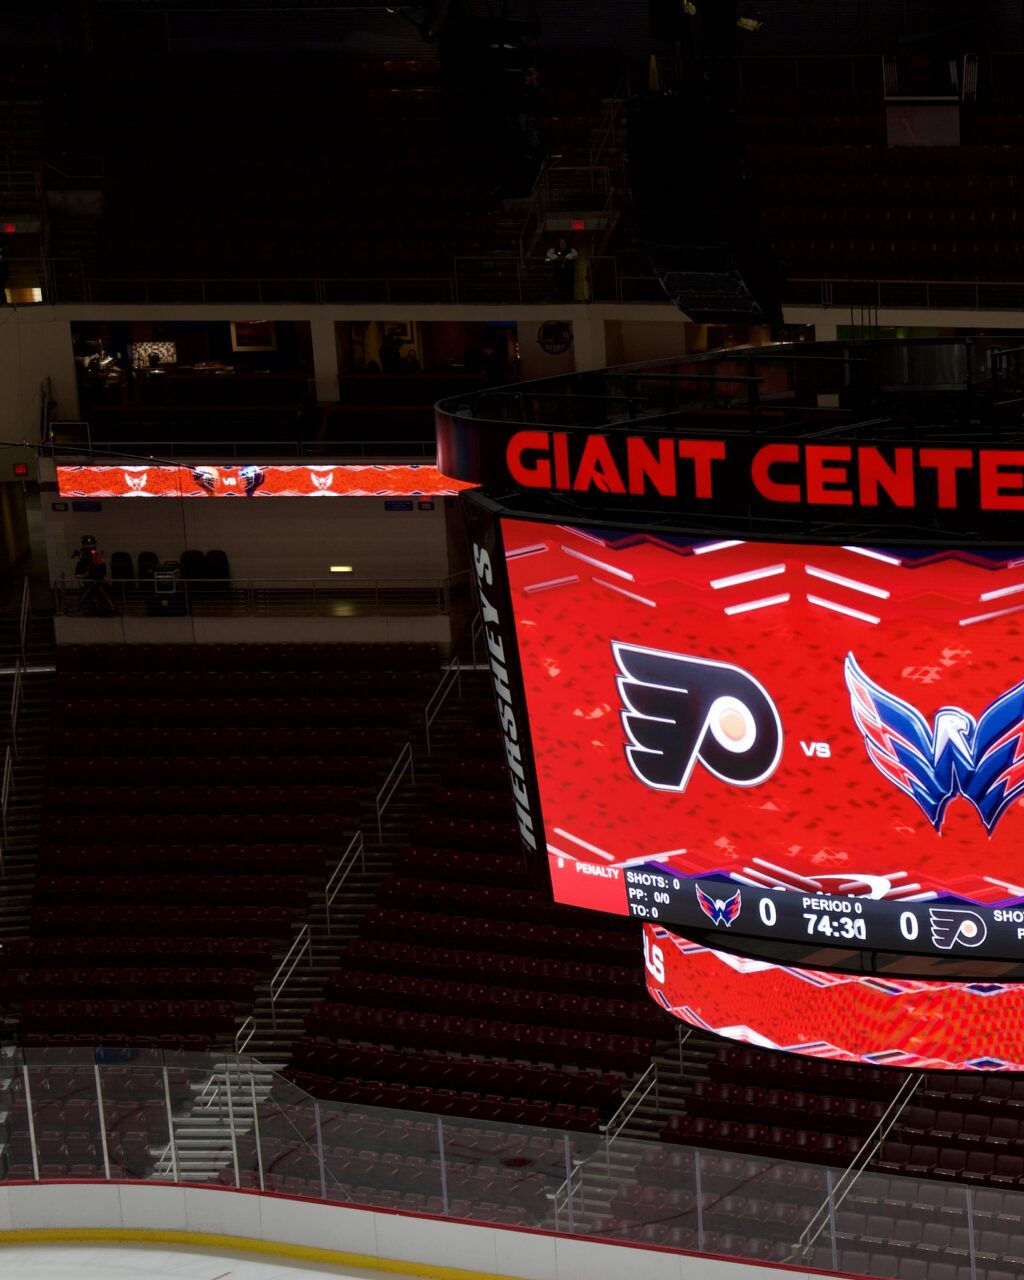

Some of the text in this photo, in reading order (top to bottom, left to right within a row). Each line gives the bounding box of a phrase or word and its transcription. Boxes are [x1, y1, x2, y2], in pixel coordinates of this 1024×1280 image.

[505, 430, 725, 498] GIANT
[474, 543, 537, 850] HERSHEY'S
[800, 740, 831, 758] VS
[576, 861, 619, 879] PENALTY
[627, 871, 680, 890] SHOTS: 0
[628, 887, 670, 905] PP: 0/0
[630, 903, 659, 918] TO: 0
[758, 898, 777, 926] 0
[802, 897, 862, 914] PERIOD 0
[900, 911, 919, 940] 0
